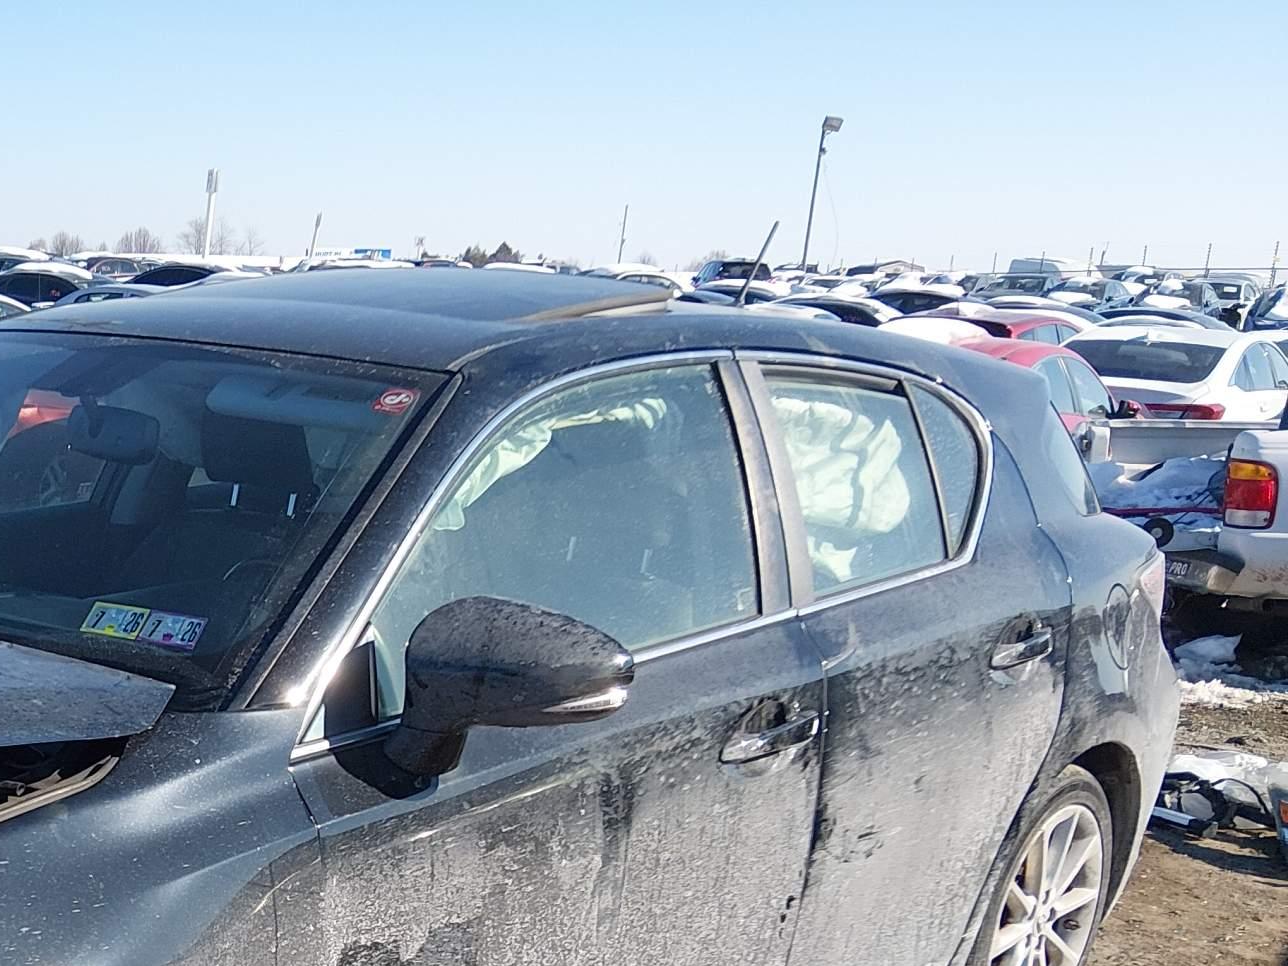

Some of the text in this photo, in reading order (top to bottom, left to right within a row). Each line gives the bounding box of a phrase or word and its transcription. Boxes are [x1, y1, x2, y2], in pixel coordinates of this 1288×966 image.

[91, 610, 145, 633] 7 26
[148, 619, 201, 643] 7 26
